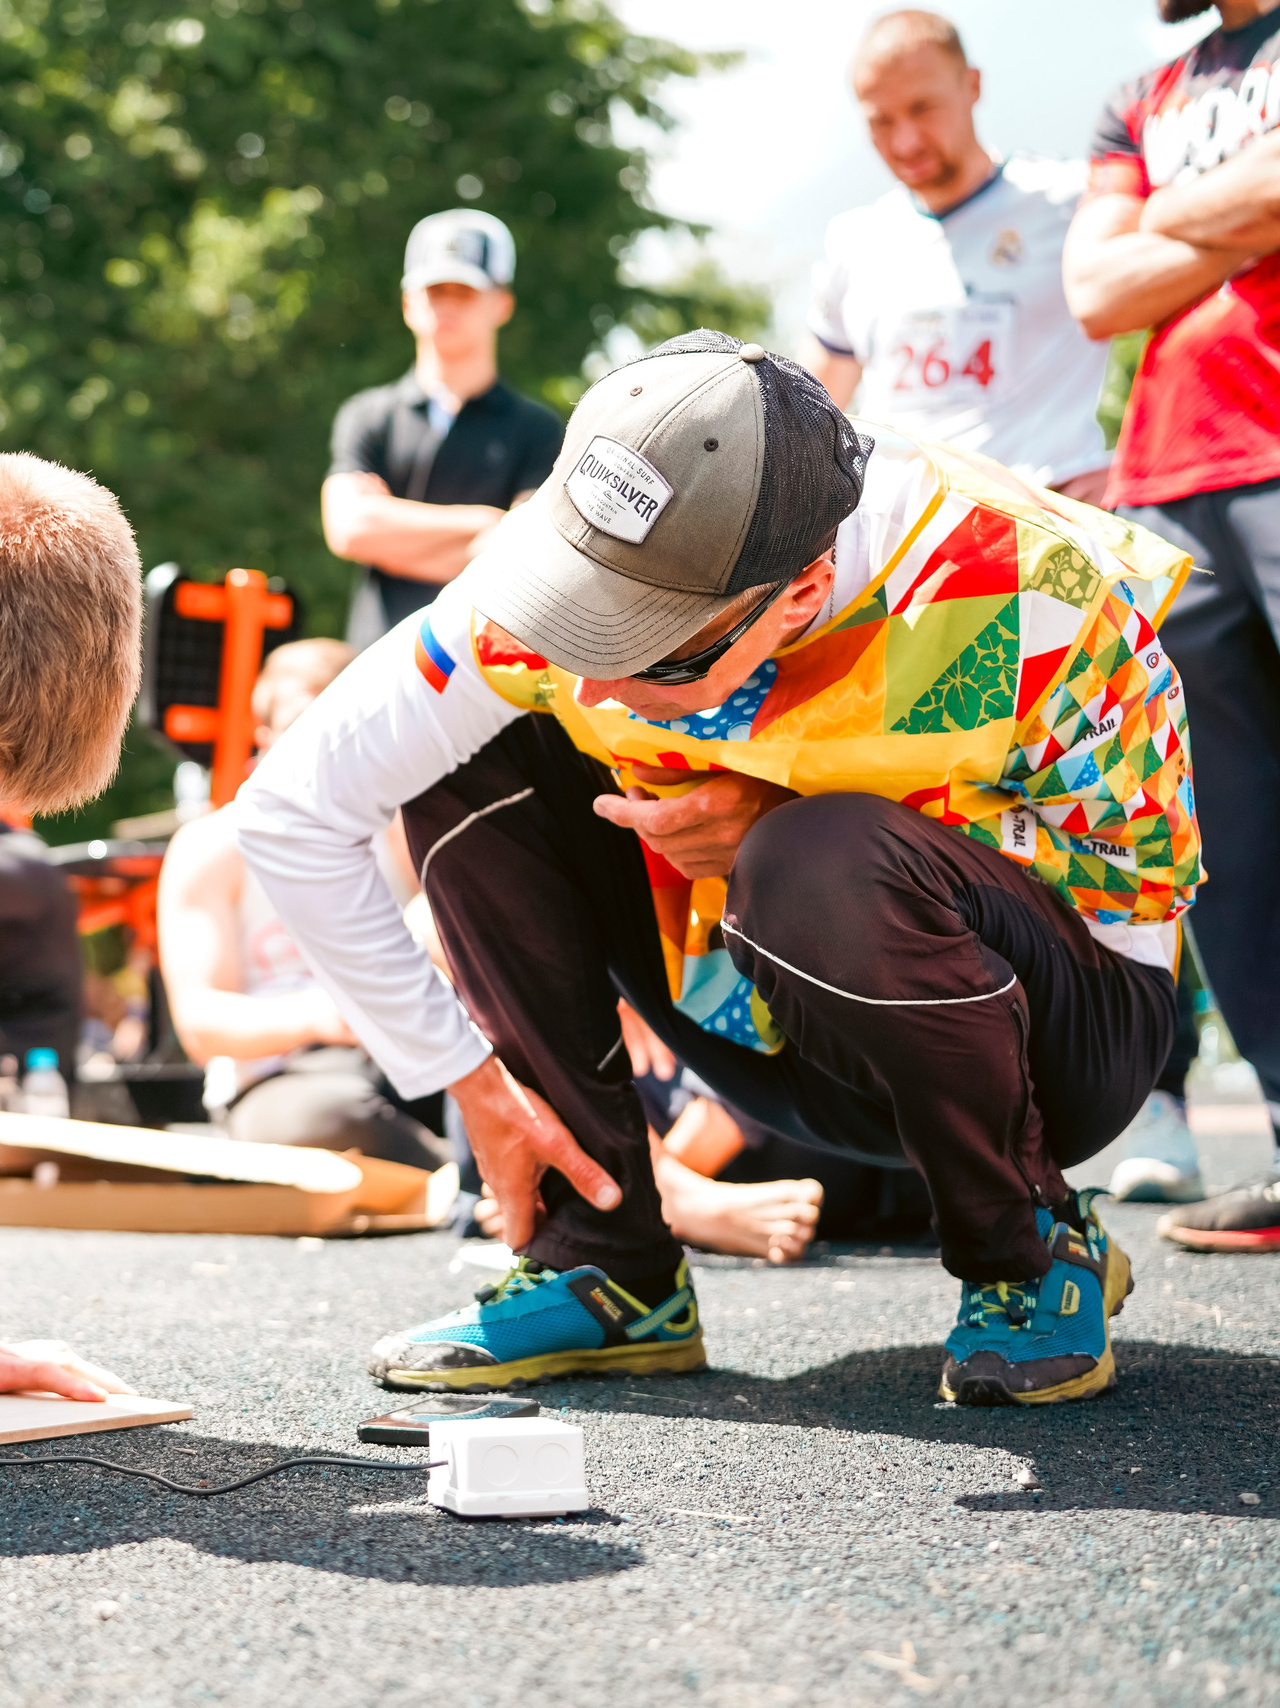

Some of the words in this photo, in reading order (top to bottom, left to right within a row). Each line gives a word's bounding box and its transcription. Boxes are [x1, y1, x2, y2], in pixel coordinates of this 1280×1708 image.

[889, 337, 995, 391] 264
[579, 453, 659, 523] QUIKSILVER
[636, 467, 655, 486] SURF
[595, 510, 612, 525] WAVE
